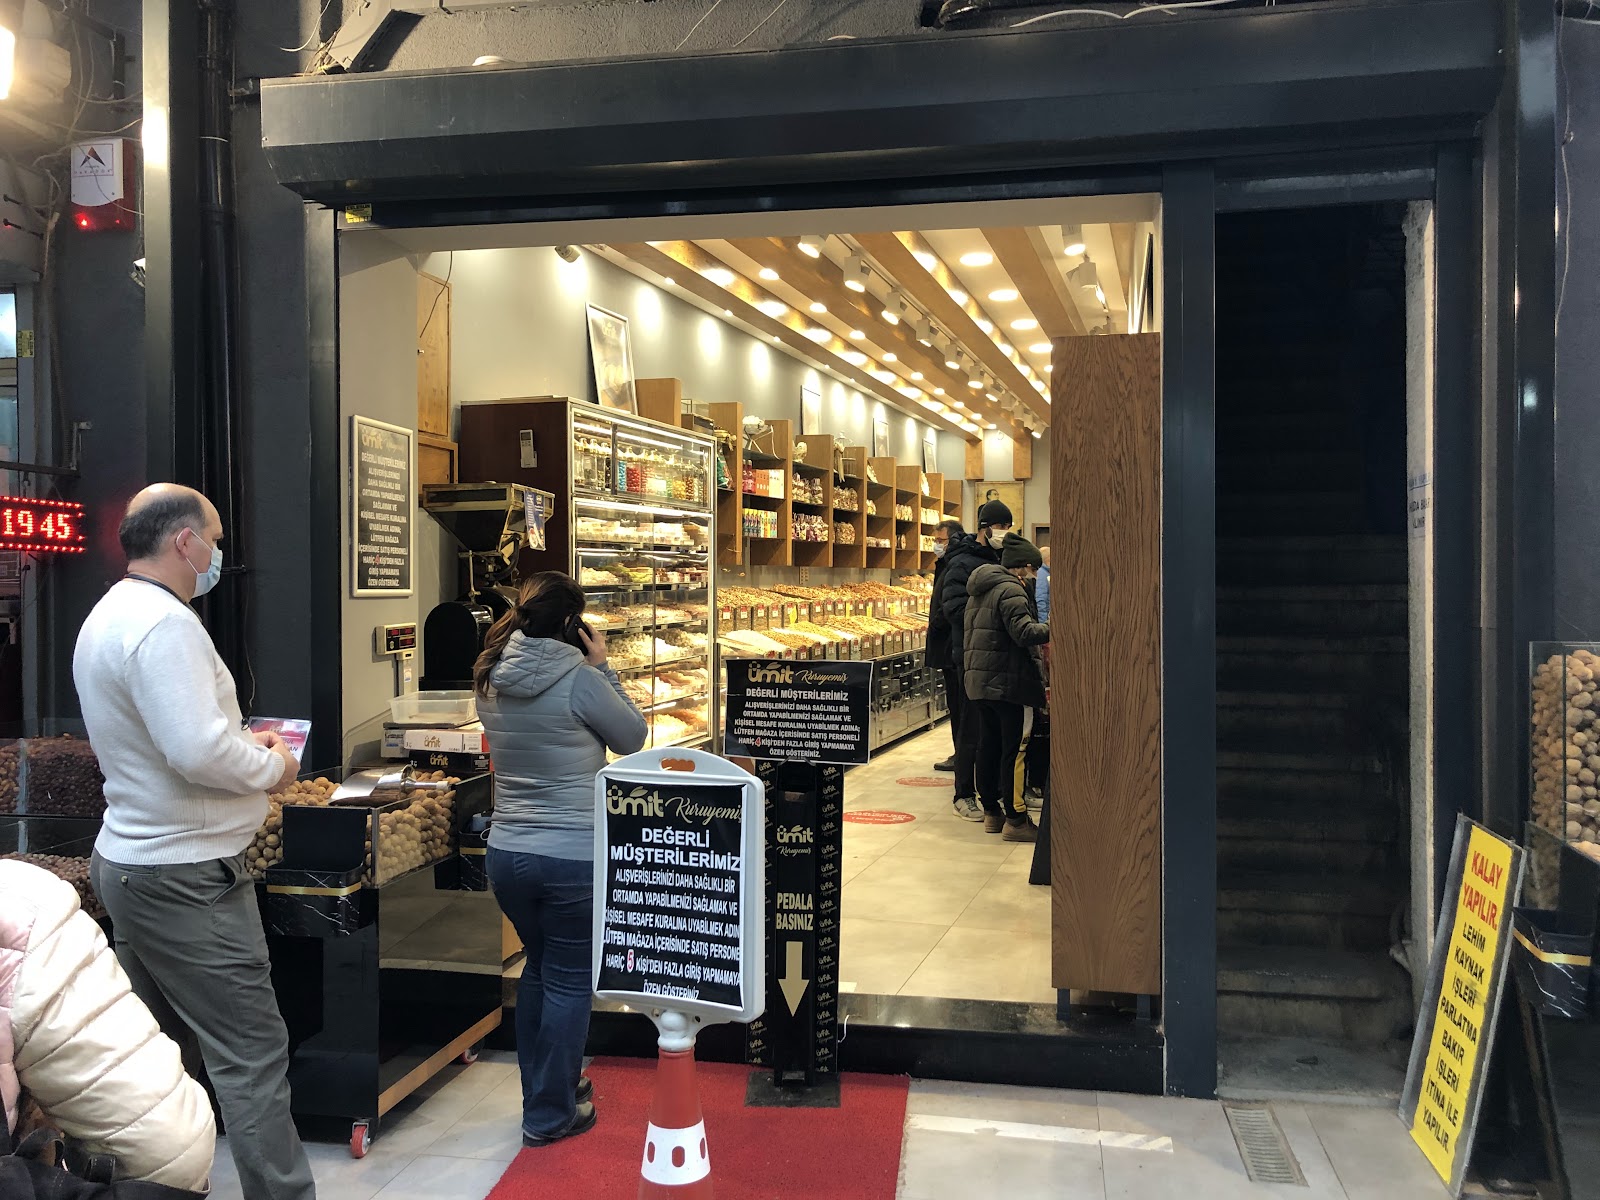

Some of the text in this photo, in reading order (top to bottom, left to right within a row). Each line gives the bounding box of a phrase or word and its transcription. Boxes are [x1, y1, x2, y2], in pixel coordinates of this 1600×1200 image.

[748, 661, 795, 684] ümit
[746, 687, 848, 701] DEĞERLİ MÜŞTERİLERİMİZ
[743, 710, 768, 718] ORTAMDA
[811, 712, 842, 722] SAĞLAMAK
[796, 703, 811, 711] DAHA
[812, 703, 838, 712] SAĞLIKLI
[840, 704, 849, 713] BİR
[734, 727, 860, 742] LÜTFEN MAĞAZA İÇERİSİNDE SATIŞ PERSONELİ
[735, 718, 755, 728] KİŞİSEL
[778, 721, 806, 729] KURALINA
[807, 721, 839, 731] UYABİLMEK
[769, 747, 785, 756] ÖZEN
[786, 740, 803, 748] FAZLA
[804, 740, 819, 749] GİRİŞ
[821, 742, 855, 751] YAPMAMAYA
[607, 785, 664, 818] ümit
[641, 826, 710, 848] DEĞERLİ
[776, 825, 813, 844] ümit
[610, 843, 741, 872] MÜŞTERİLERİMİZ
[1470, 850, 1503, 890] KALAY
[615, 867, 735, 894] ALIŞVERİŞLERİNİZİ DAHA SAĞLIKLI BİR
[612, 889, 738, 916] ORTAMDA YAPABİLMENİZİ SAĞLAMAK VE
[776, 892, 813, 911] PEDALA
[1462, 881, 1498, 931] YAPILIR.
[627, 911, 653, 927] MESAFE
[654, 915, 687, 932] KURALINA
[688, 917, 723, 937] UYABİLMEK
[775, 912, 814, 931] BASINIZ
[626, 931, 654, 949] MAĞAZA
[654, 933, 690, 954] İÇERİSİNDE
[691, 941, 709, 959] SATIŞ
[1462, 921, 1486, 954] LEHİM
[606, 952, 625, 972] HARİÇ
[626, 948, 634, 973] 5
[635, 955, 663, 976] KİŞİ'DEN
[663, 961, 683, 978] FAZLA
[684, 959, 702, 982] GİRİŞ
[1453, 945, 1485, 985] KAYNAK
[1439, 996, 1478, 1046] PARLATMA
[1441, 1028, 1465, 1067] BAKIR
[1436, 1052, 1460, 1094] İŞLERİ
[1425, 1074, 1458, 1128] İTİNA İLE
